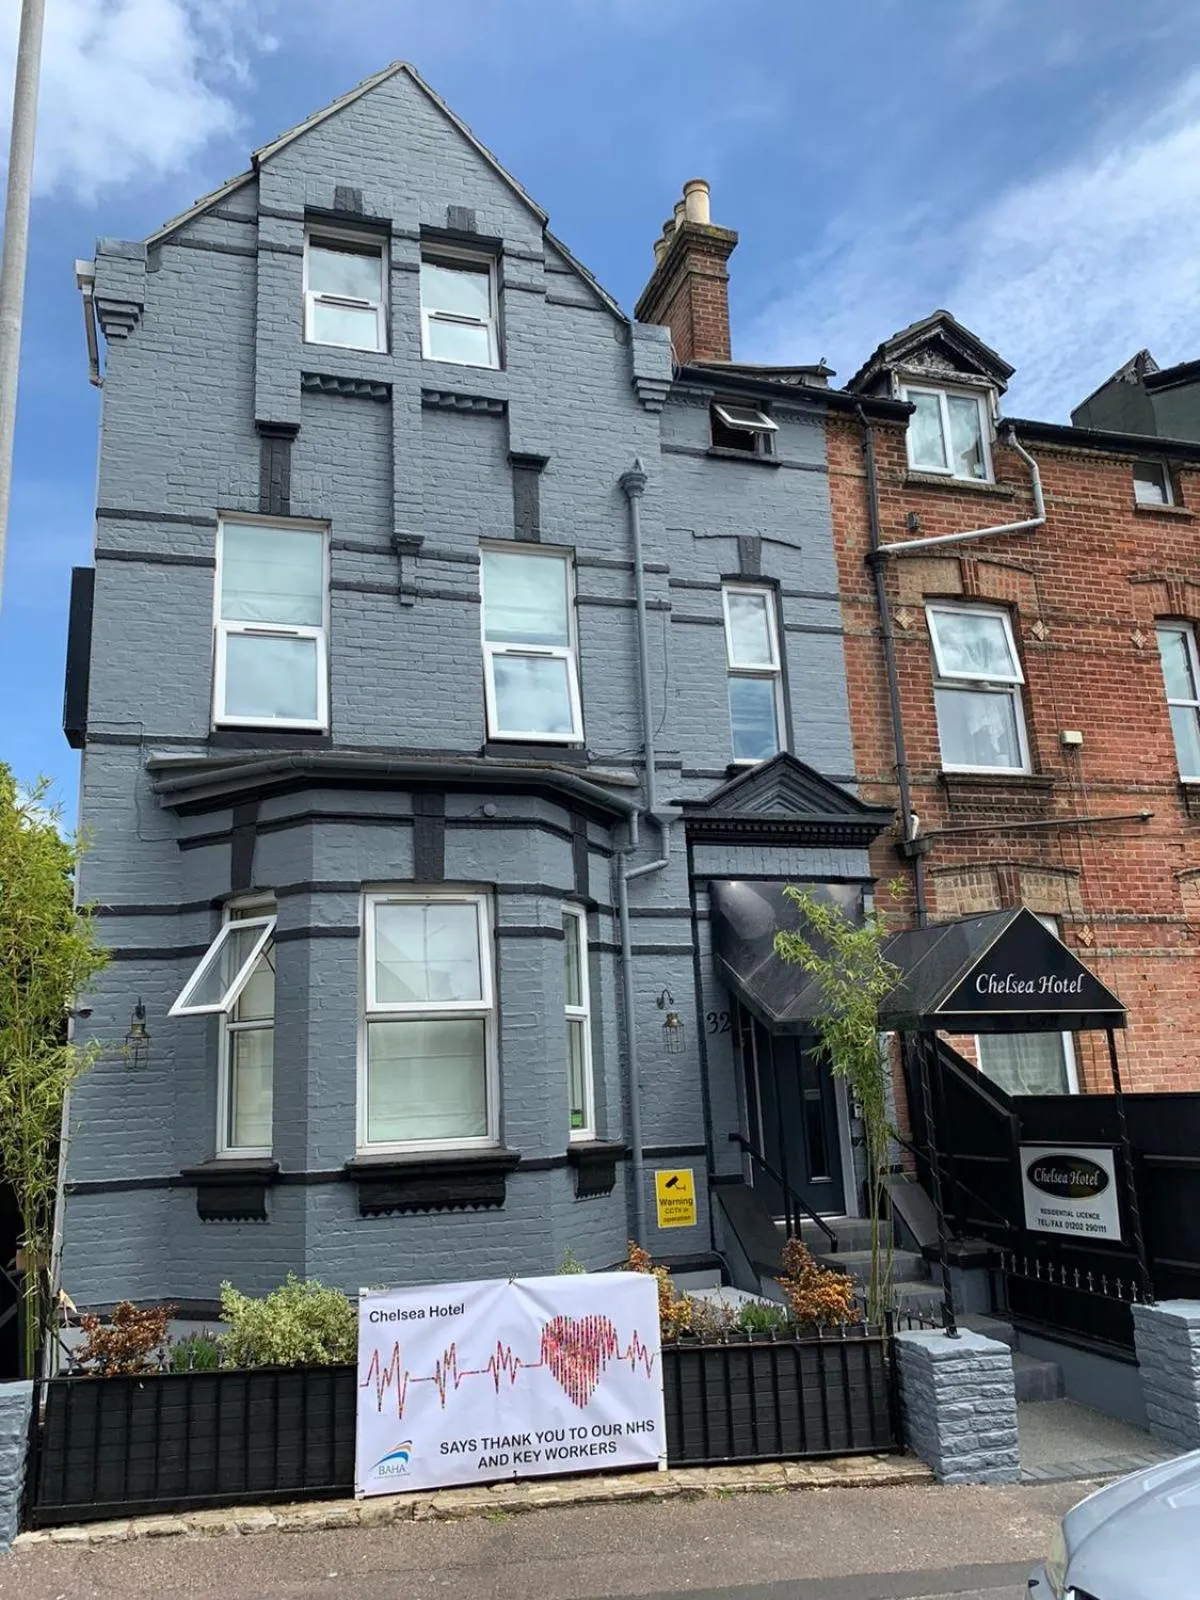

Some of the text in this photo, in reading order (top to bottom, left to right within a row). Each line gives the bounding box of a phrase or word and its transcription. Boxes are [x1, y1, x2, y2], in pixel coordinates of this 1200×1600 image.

[975, 973, 1085, 994] Chelsea Hotel
[706, 1011, 731, 1035] 32
[1033, 1167, 1100, 1186] Chelsea Hotel
[369, 1303, 465, 1324] Chelsea Hotel
[440, 1419, 655, 1455] SAYS THANK YOU TO OUR NHS
[478, 1441, 617, 1470] AND KEY WORKERS
